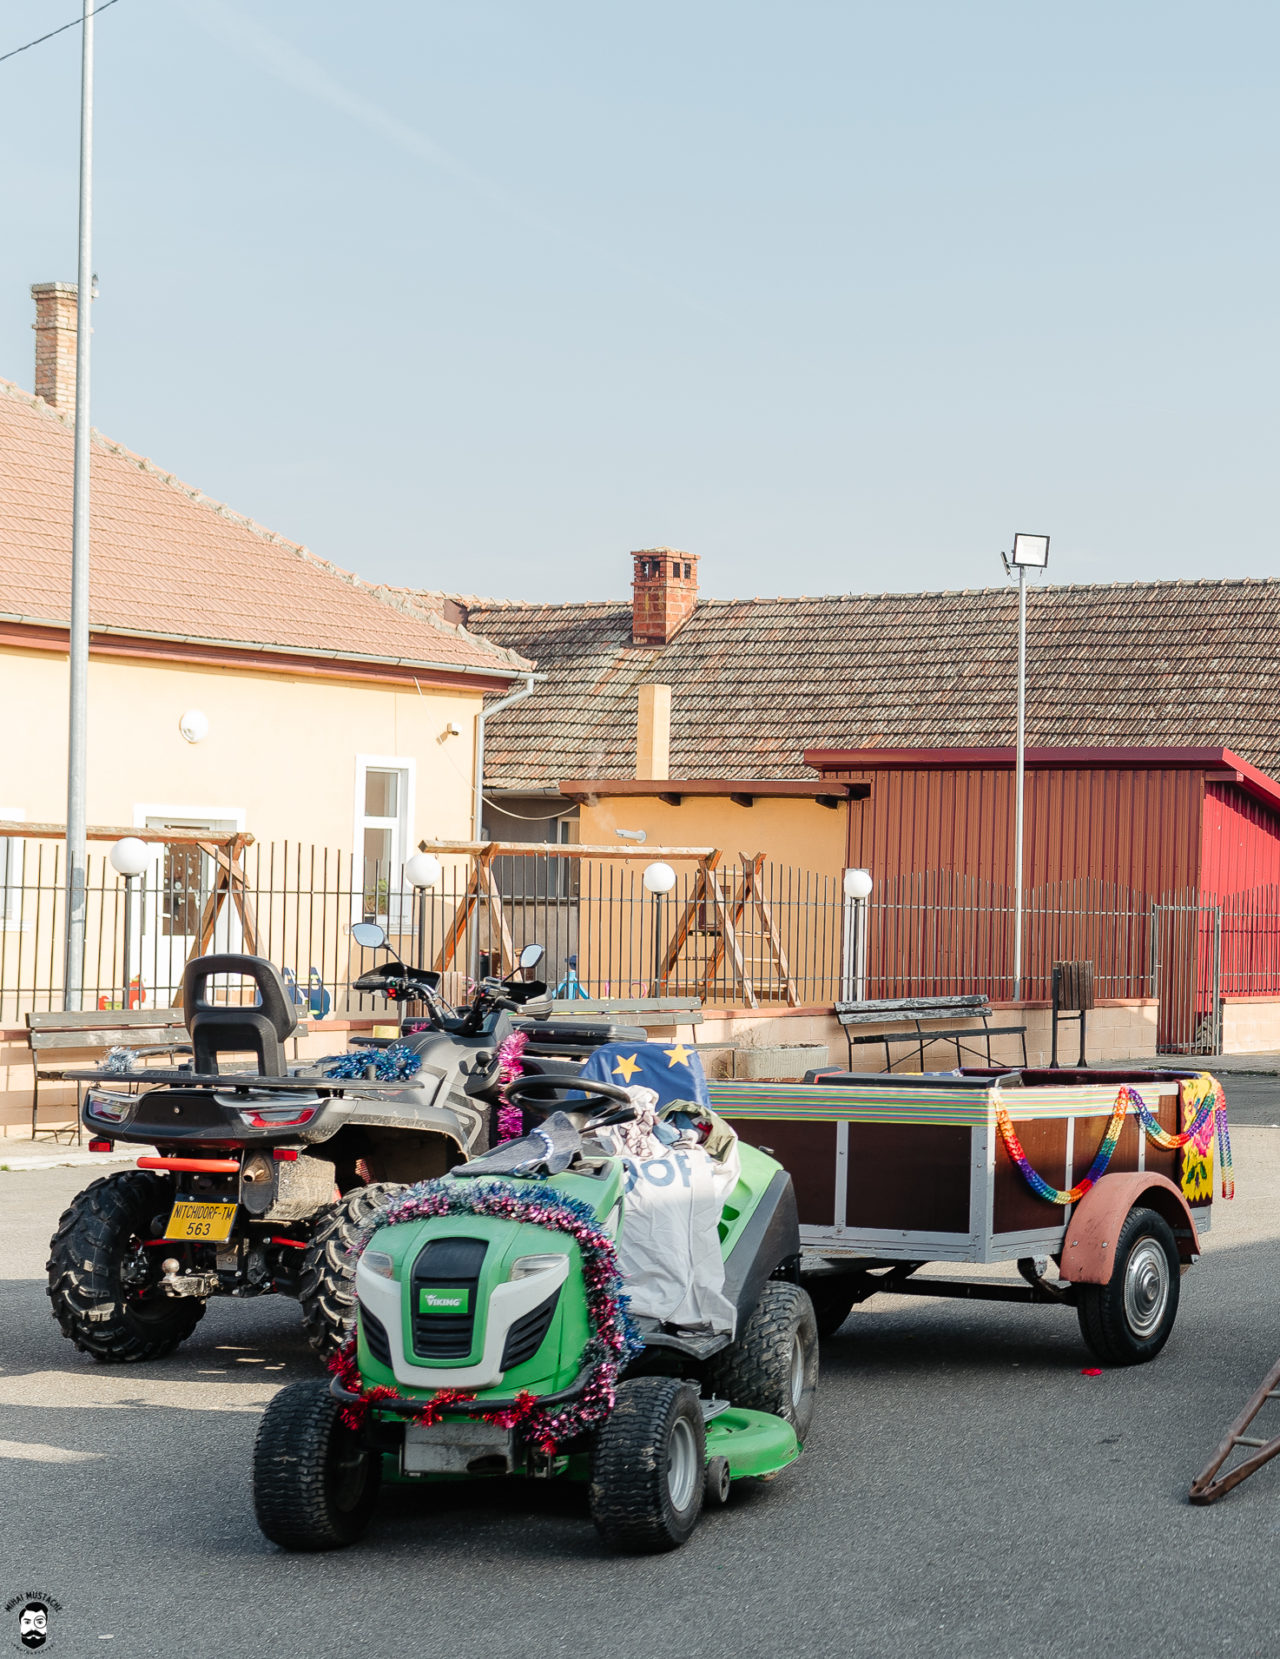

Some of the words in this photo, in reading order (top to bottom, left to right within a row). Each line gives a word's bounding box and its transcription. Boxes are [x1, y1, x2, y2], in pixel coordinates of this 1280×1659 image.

[173, 1204, 235, 1221] NITCHIDORF-TM
[186, 1222, 211, 1236] 563
[425, 1295, 462, 1307] VIKING
